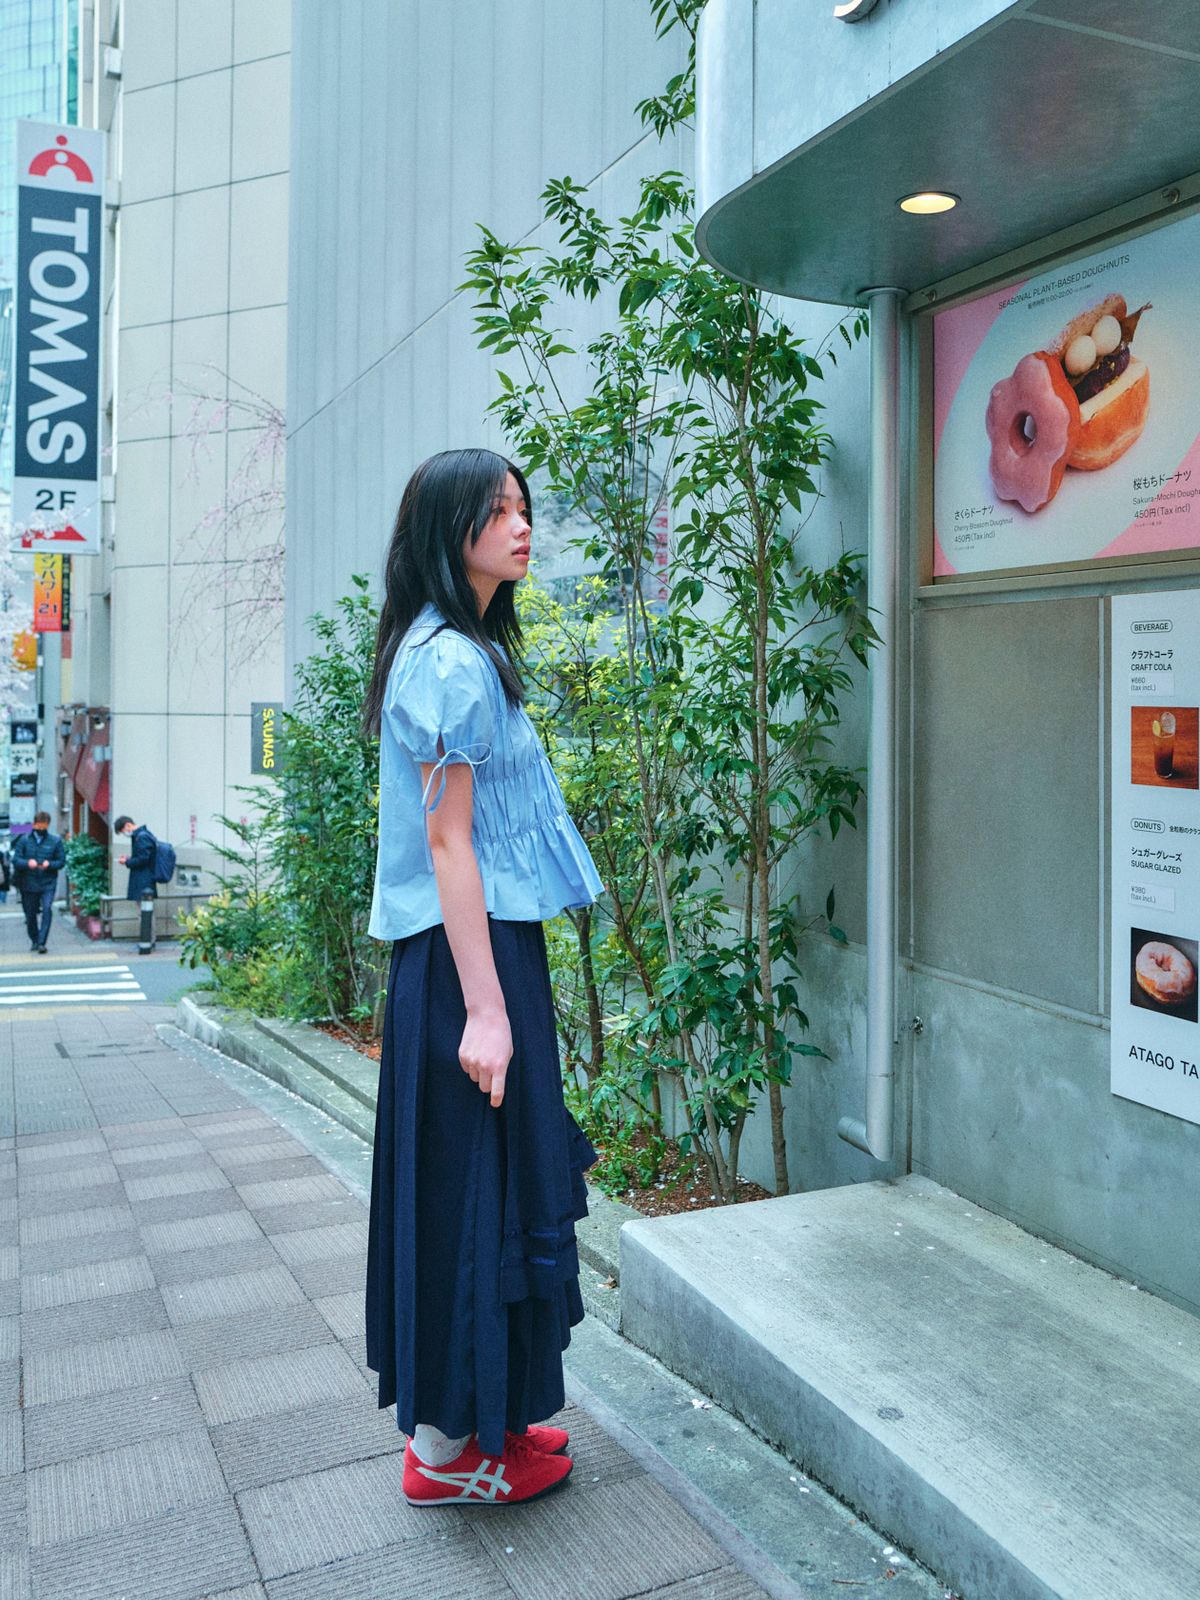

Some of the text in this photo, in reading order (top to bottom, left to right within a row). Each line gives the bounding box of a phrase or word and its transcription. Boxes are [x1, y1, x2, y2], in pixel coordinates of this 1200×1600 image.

[999, 254, 1130, 310] SEASONAL PLANT-BASED DOUGHNUTS
[26, 207, 90, 465] TOMAS
[1133, 470, 1192, 490] 桜もちドーナツ
[35, 489, 77, 511] 2F
[1133, 491, 1176, 506] Sakura-Mochi
[954, 504, 995, 520] さくらドーナツ
[1134, 622, 1169, 632] BEVERAGE
[1131, 649, 1174, 660] クラフトコーラ
[1130, 663, 1173, 671] CRAFT COLA
[262, 708, 275, 769] SAUNAS
[1133, 820, 1162, 831] DONUTS
[1131, 846, 1183, 862] シュガーグレーズ
[1130, 860, 1182, 875] SUGAR GLAZED
[1128, 1045, 1175, 1071] ATAGO
